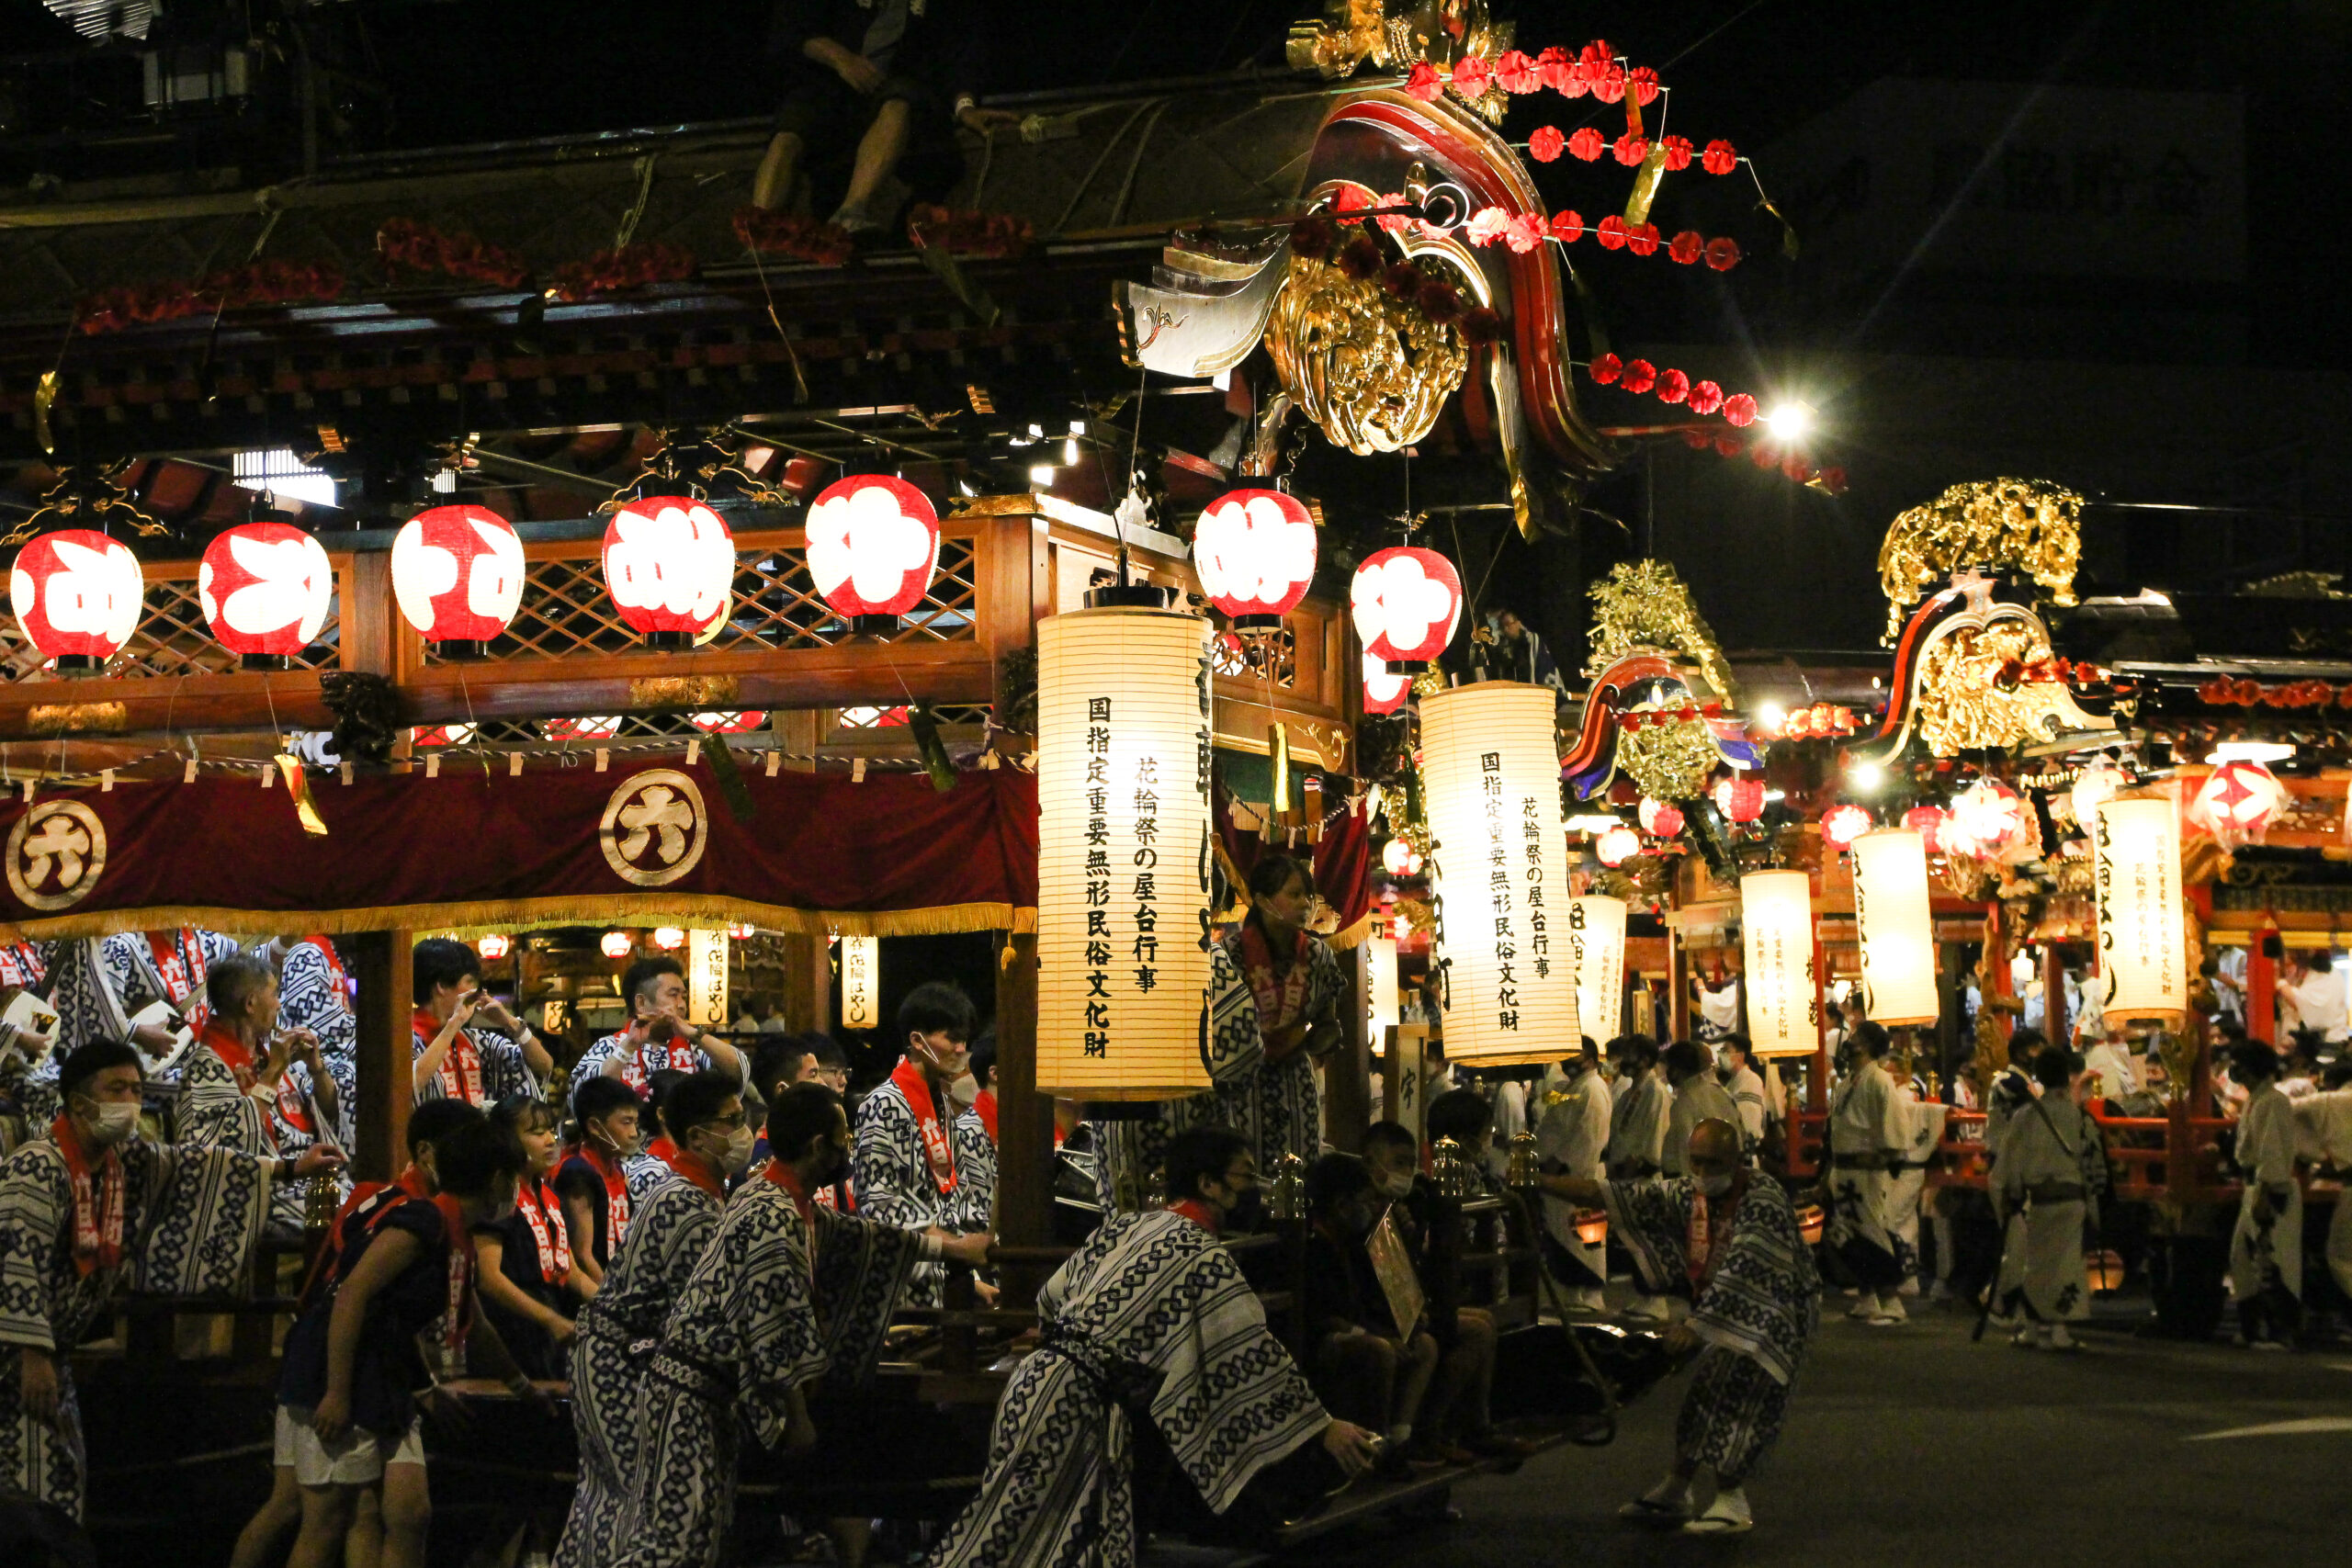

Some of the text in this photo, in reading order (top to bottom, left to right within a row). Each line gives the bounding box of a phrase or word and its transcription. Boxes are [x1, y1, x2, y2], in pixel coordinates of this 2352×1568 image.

[1082, 696, 1112, 1060] 国指定重要無形民俗文化財
[1131, 756, 1160, 995] 花輪祭の屋台行事
[1480, 751, 1521, 1032] 国指定重要無形民俗文化財
[1521, 796, 1552, 980] 花輪祭の屋台行事
[521, 1201, 555, 1272] 六日町
